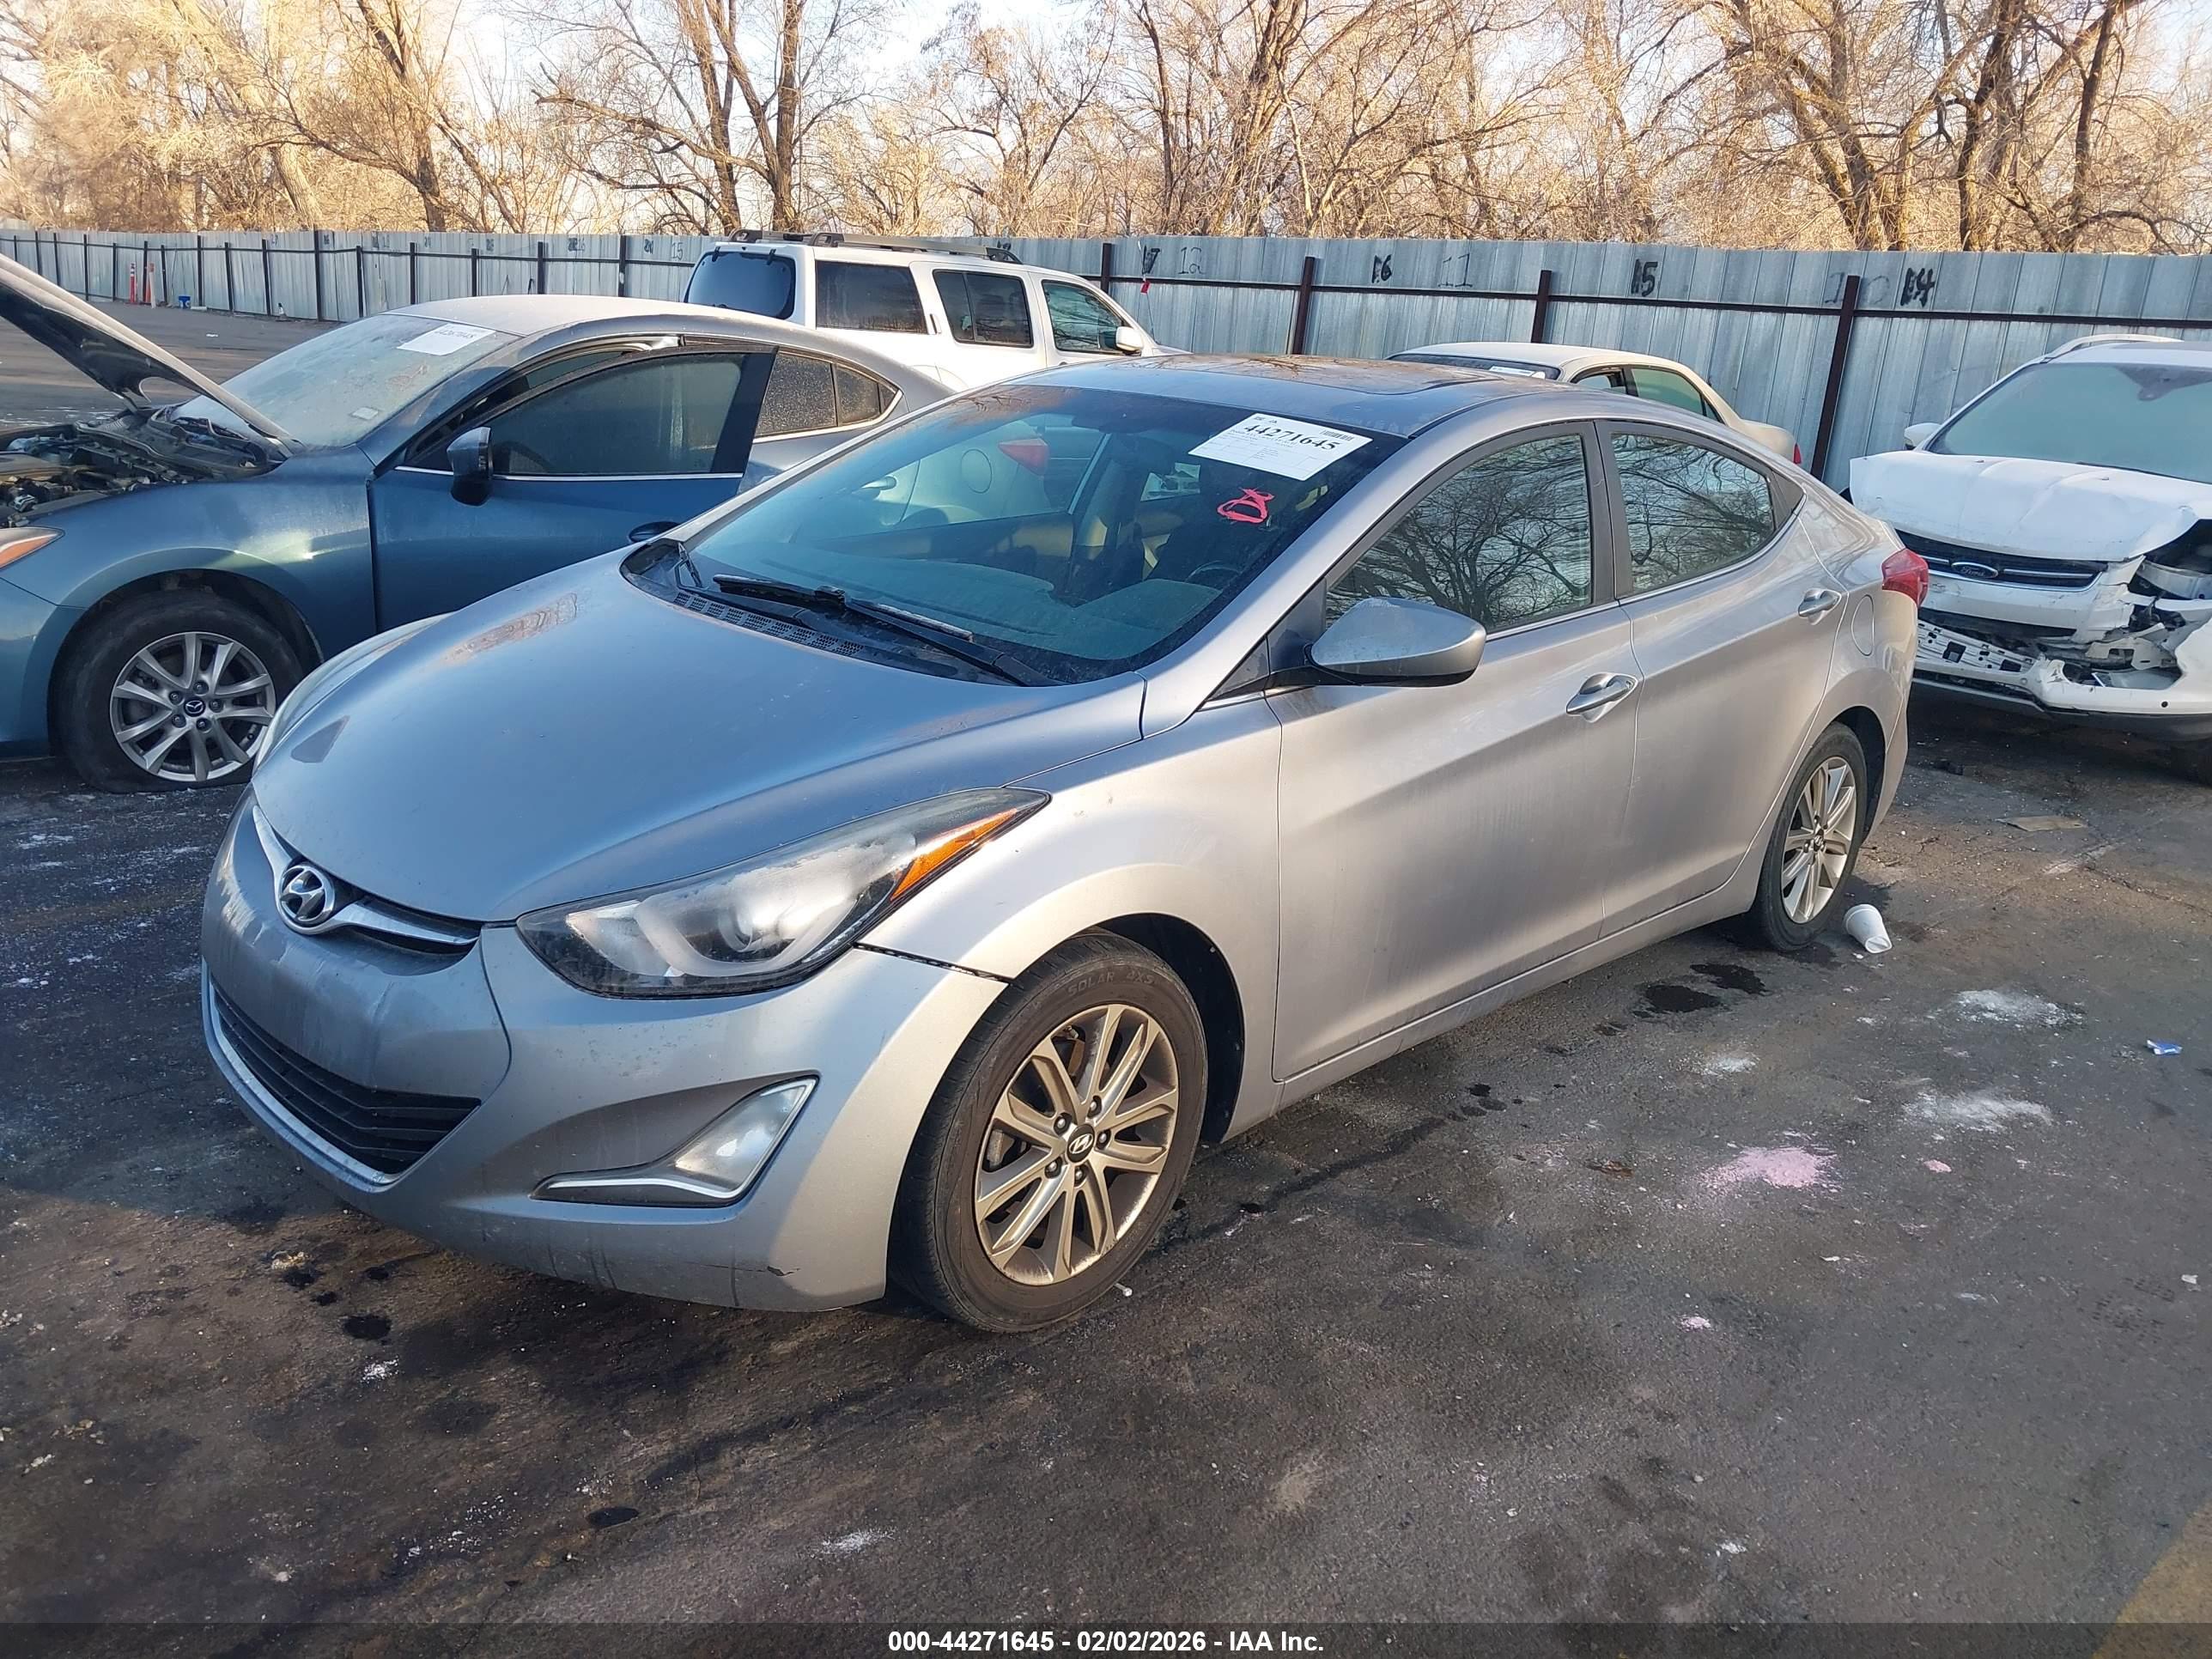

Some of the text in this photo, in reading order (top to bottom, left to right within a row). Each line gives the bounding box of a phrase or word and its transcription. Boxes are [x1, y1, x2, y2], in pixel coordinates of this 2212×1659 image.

[672, 241, 684, 261] 15
[1178, 246, 1206, 275] 12
[1631, 258, 1658, 297] 15
[1244, 424, 1341, 451] 44271645
[1067, 971, 1115, 996] SOLAR
